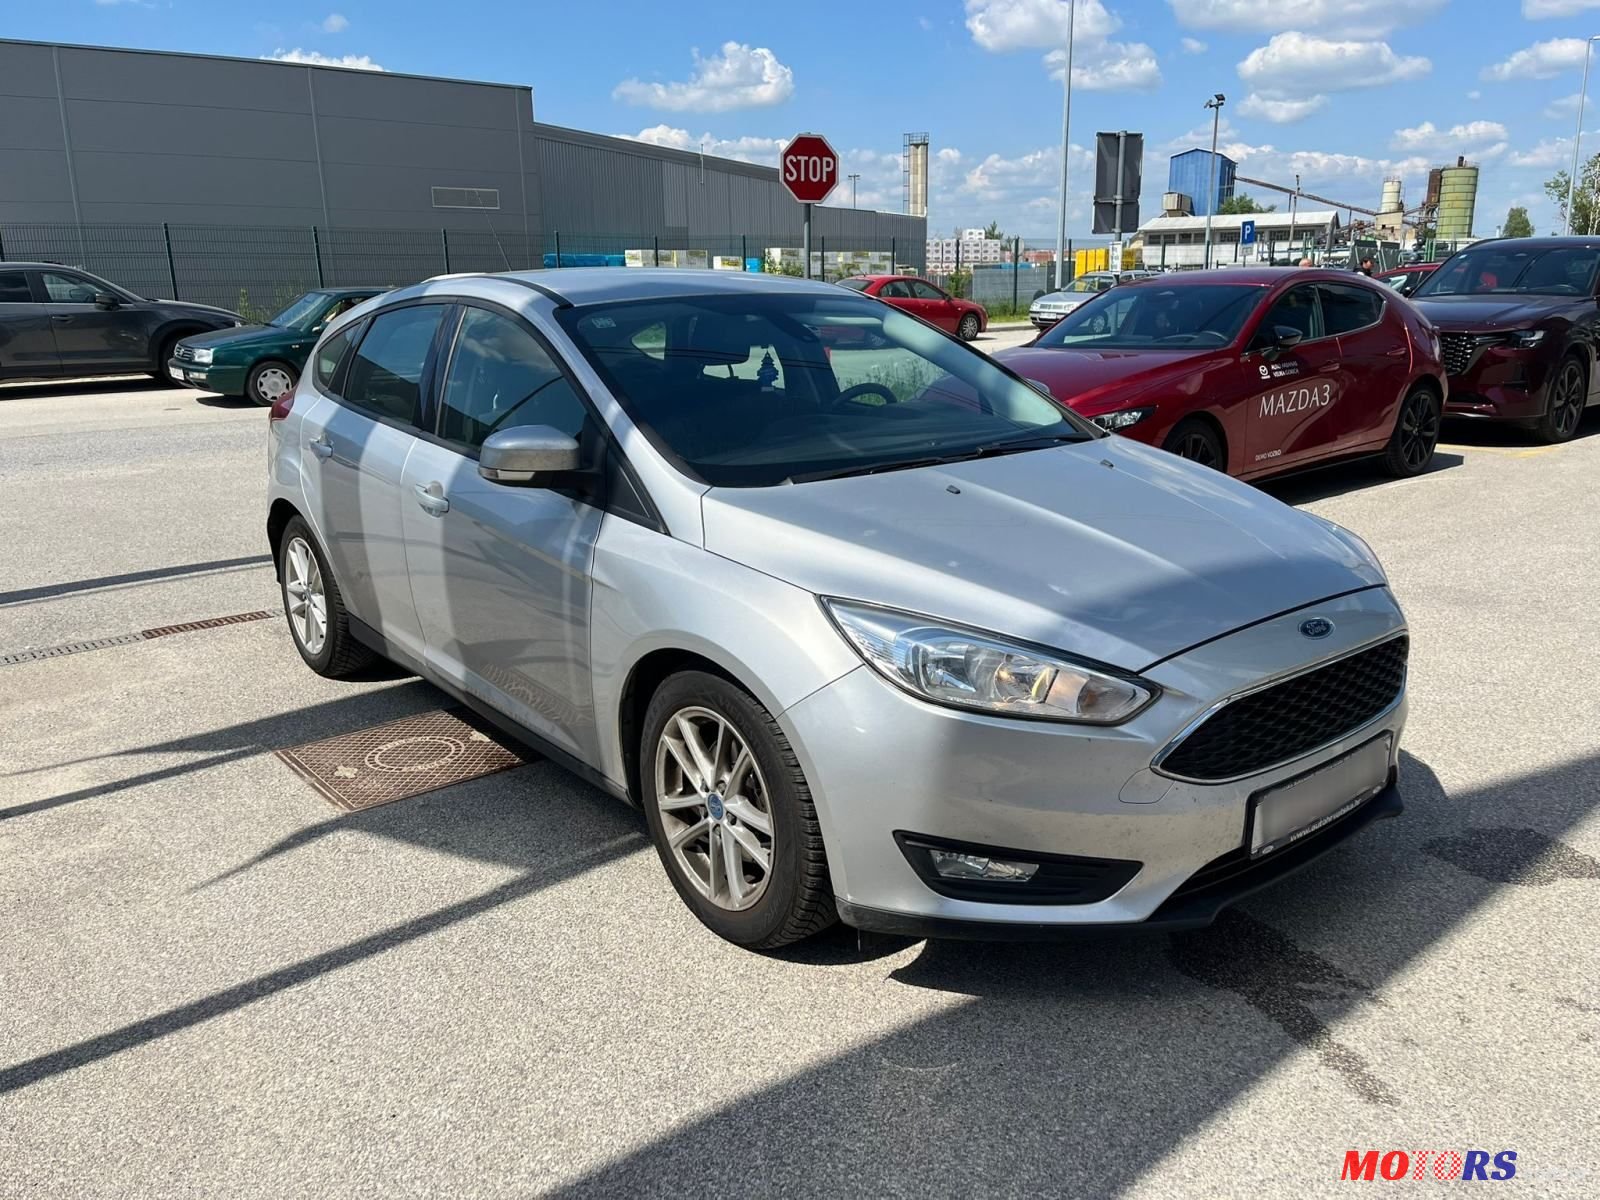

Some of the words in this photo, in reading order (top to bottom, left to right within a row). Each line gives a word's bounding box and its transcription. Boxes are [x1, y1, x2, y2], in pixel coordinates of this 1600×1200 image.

[785, 155, 834, 182] STOP
[1244, 224, 1251, 240] P
[1259, 384, 1330, 418] MAZDA3
